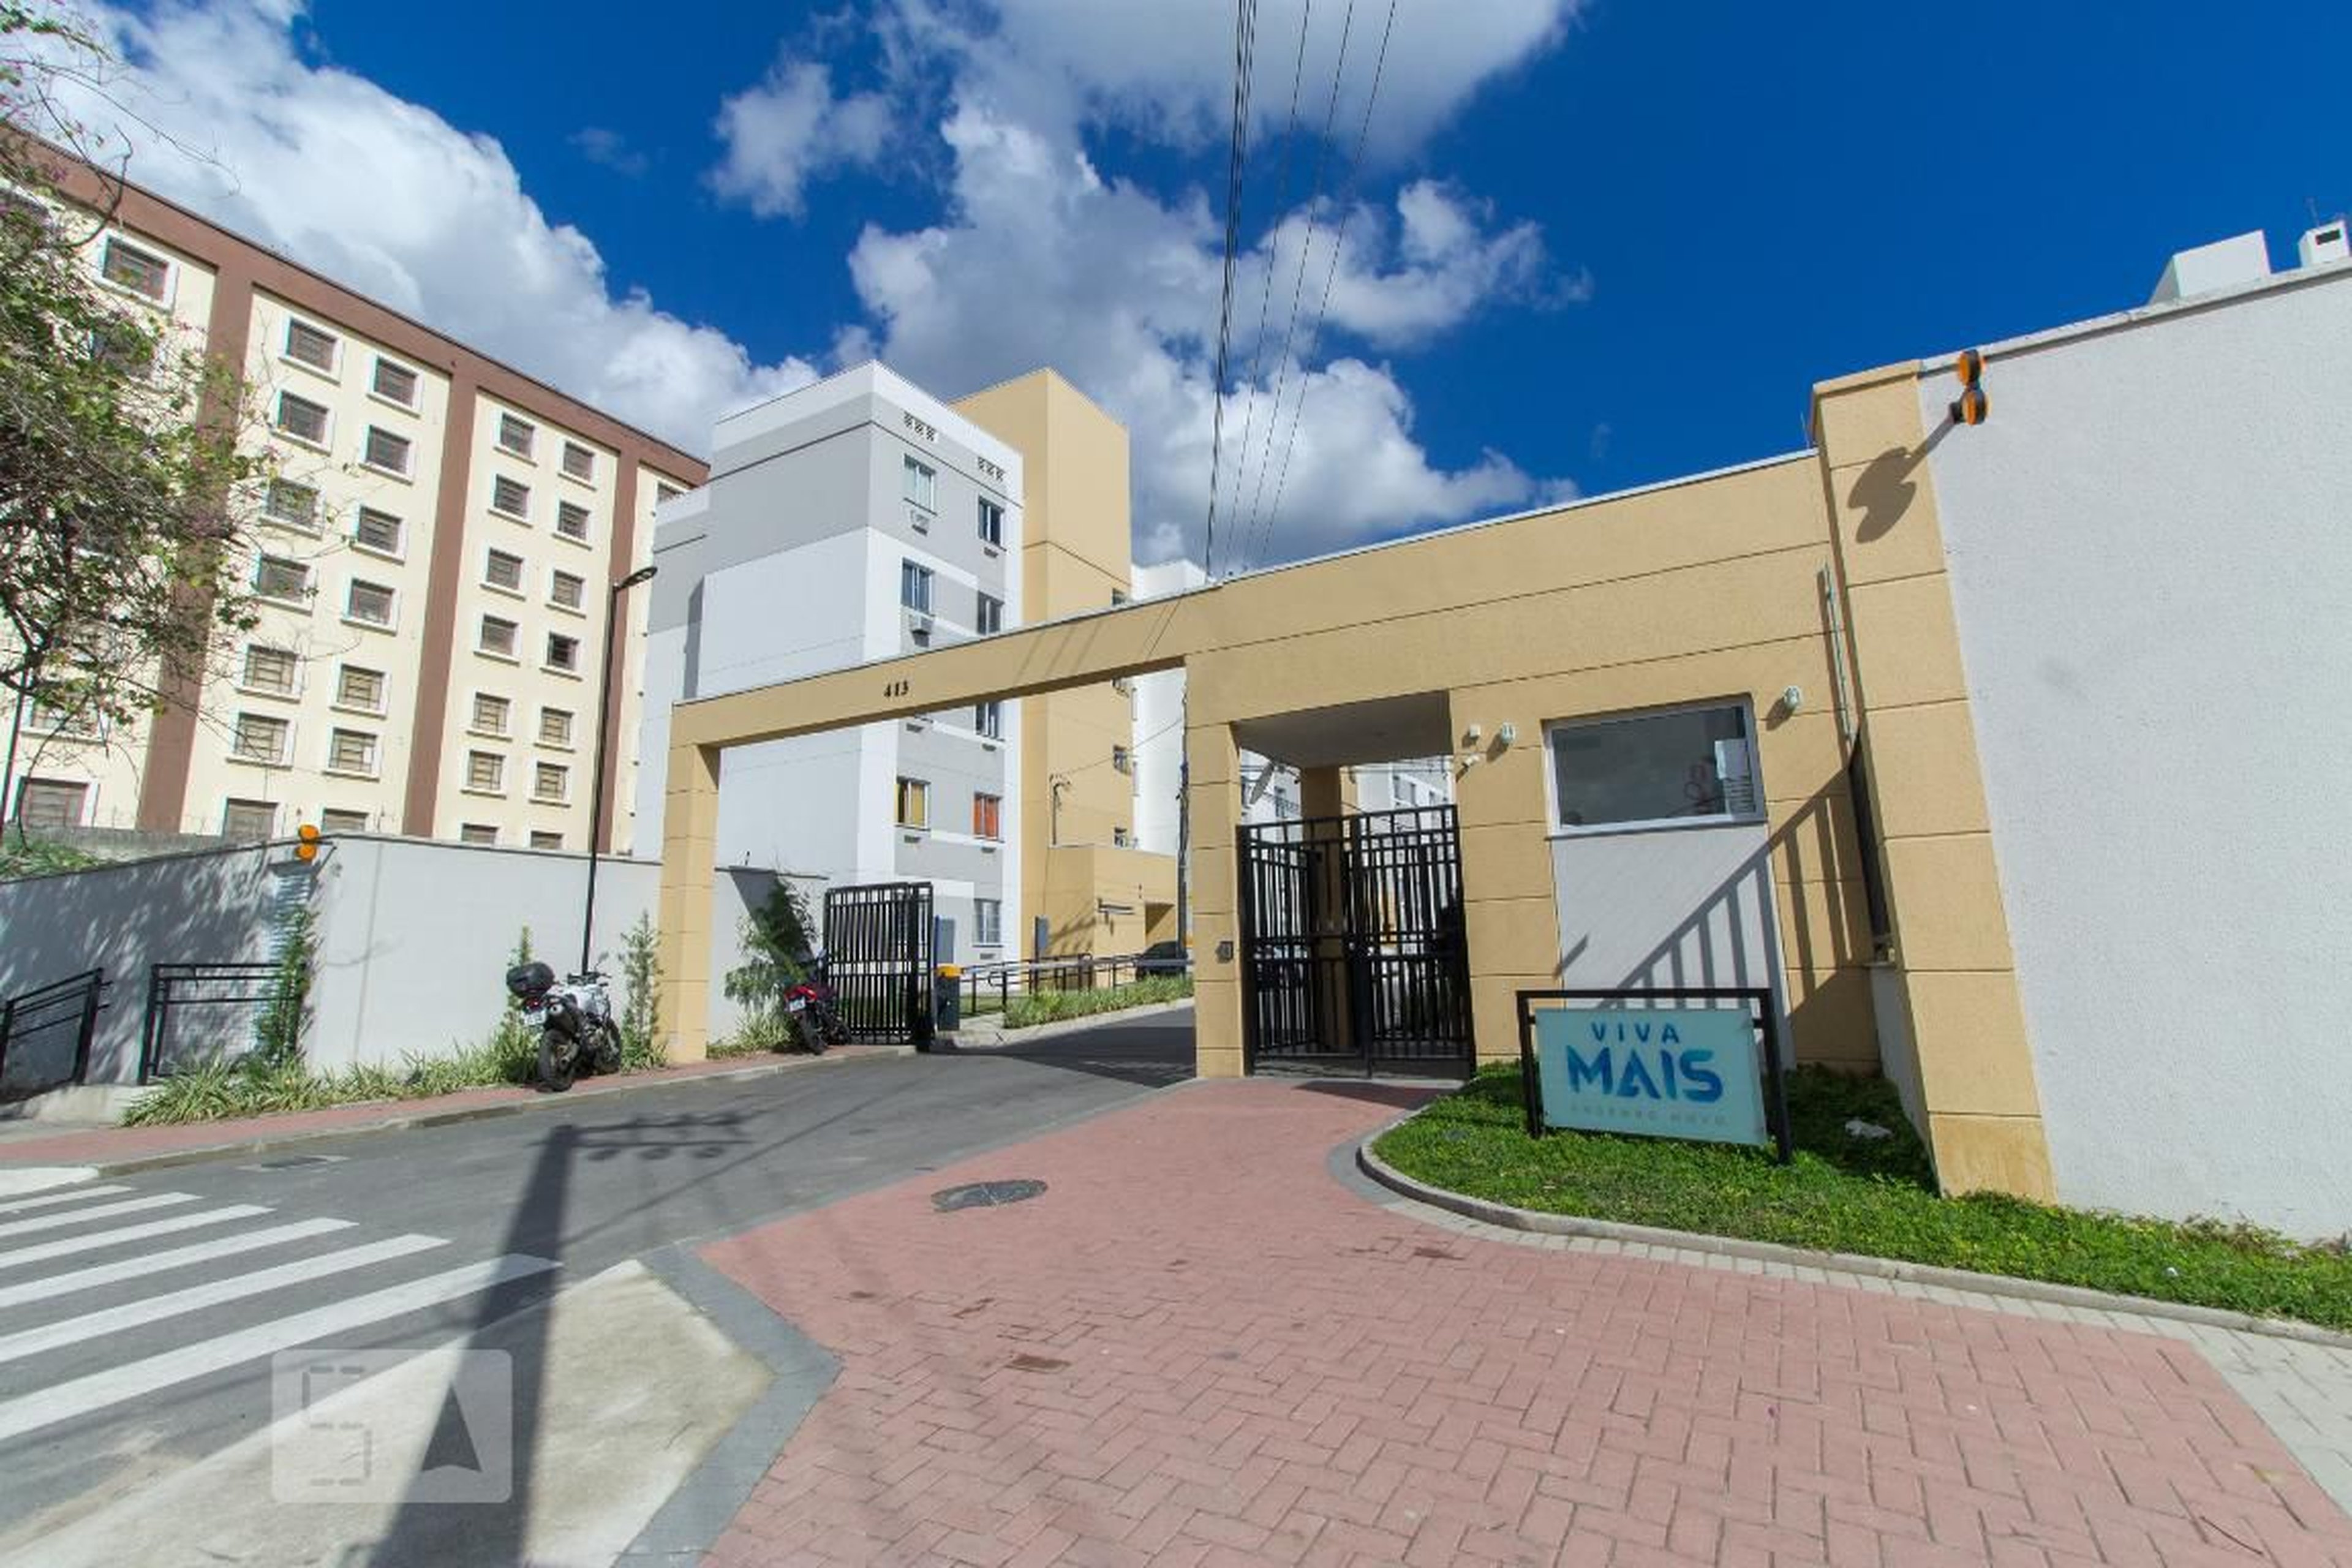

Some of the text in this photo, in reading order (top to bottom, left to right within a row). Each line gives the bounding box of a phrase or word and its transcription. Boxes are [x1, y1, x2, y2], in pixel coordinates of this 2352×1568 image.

[883, 680, 909, 697] 413
[1591, 1022, 1679, 1043] VIVA
[1566, 1044, 1724, 1103] MAIS
